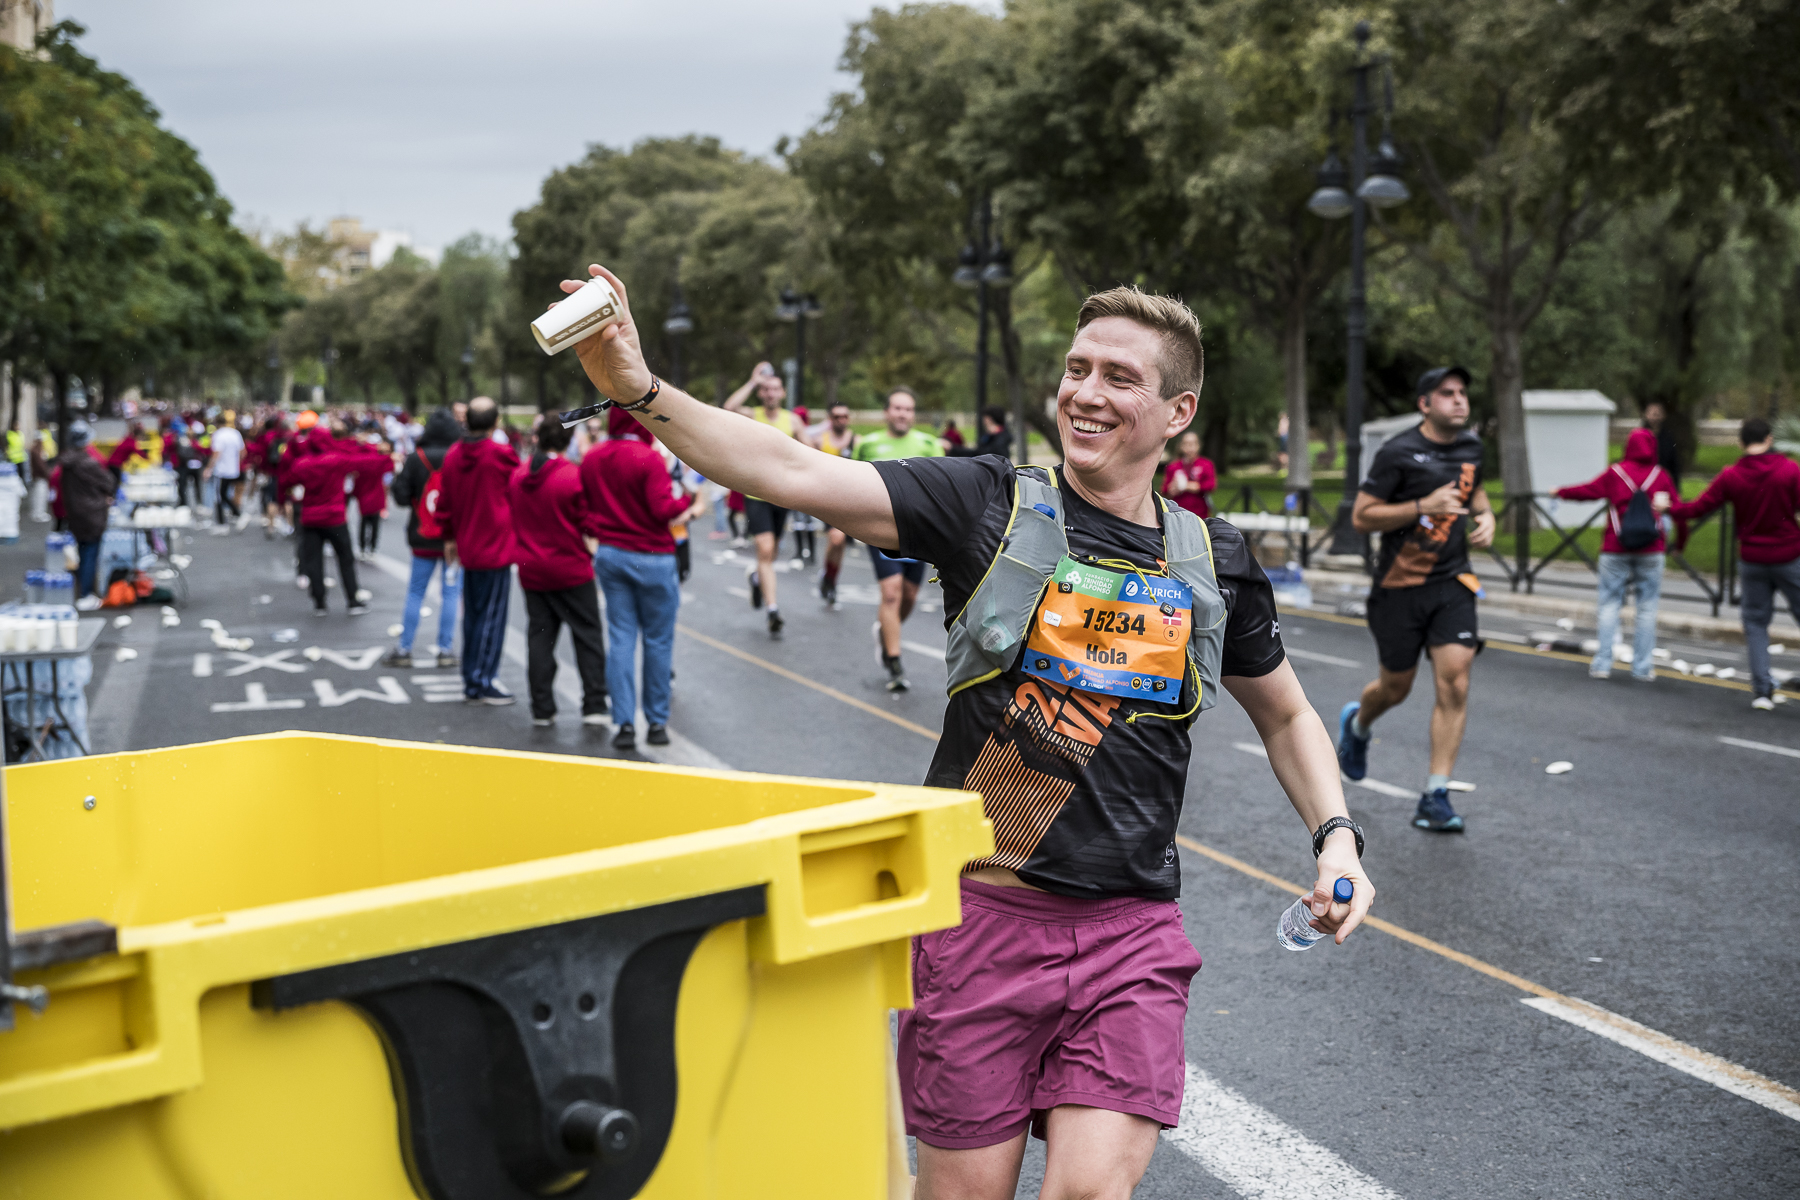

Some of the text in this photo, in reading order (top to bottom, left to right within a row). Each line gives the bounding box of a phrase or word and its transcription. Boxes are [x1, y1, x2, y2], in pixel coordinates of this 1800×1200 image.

[1081, 583, 1111, 595] ALFONSO
[1083, 577, 1113, 590] TRINIDAD
[1141, 586, 1182, 599] ZURICH
[1083, 607, 1146, 636] 15234
[1168, 630, 1174, 638] 5
[1086, 643, 1128, 665] Hola
[1105, 679, 1129, 687] ALFONSO
